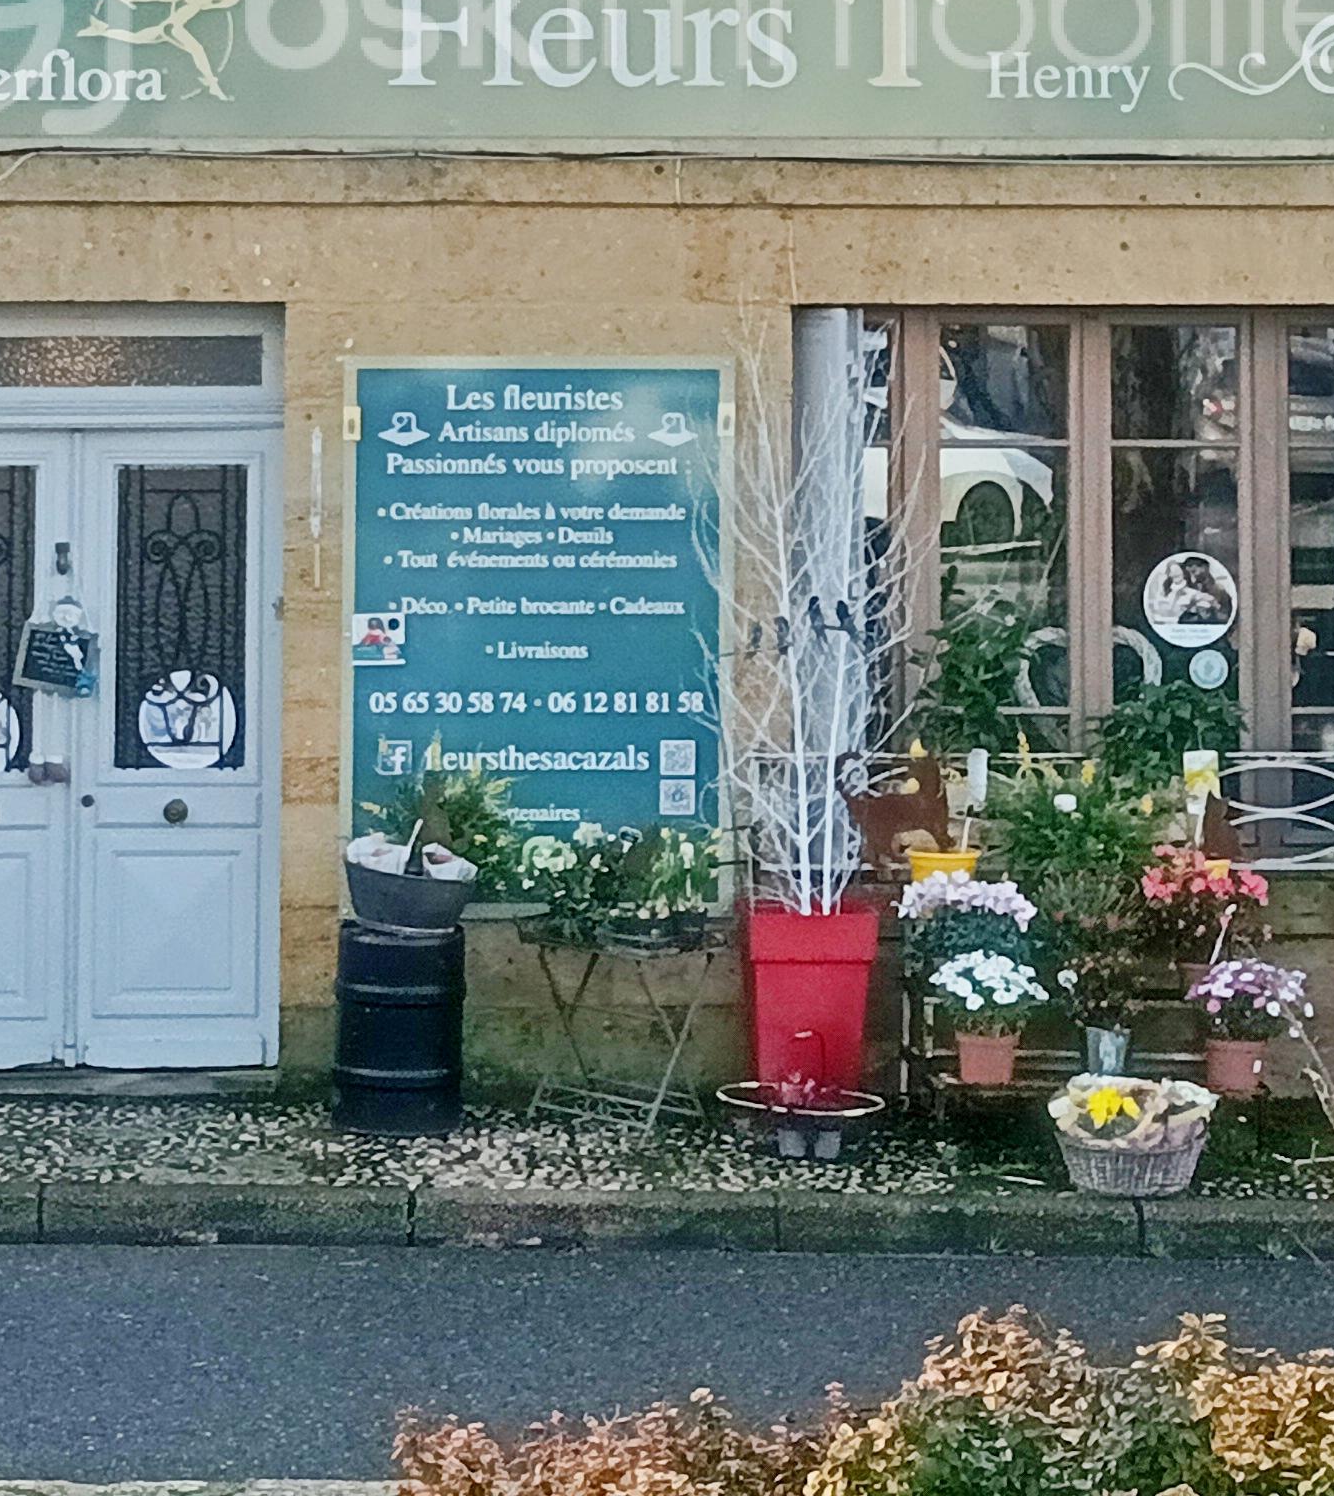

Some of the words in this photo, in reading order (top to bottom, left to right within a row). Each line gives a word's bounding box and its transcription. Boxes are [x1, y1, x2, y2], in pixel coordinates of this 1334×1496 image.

[986, 51, 1151, 112] Henry
[446, 383, 496, 411] Les
[503, 384, 624, 411] fleuristes
[437, 420, 530, 443] Artisans
[534, 421, 636, 447] diplomés
[386, 453, 507, 475] Passionnés
[512, 458, 565, 475] vous
[389, 502, 473, 521] Créations
[477, 502, 542, 521] florales
[559, 505, 605, 521] votre
[607, 502, 687, 521] demande
[462, 526, 543, 549] Mariages
[557, 526, 614, 545] Deuils
[398, 549, 438, 569] Tout
[446, 550, 550, 569] événements
[553, 554, 576, 569] ou
[579, 550, 678, 569] cérémonies
[399, 596, 448, 616] Déco
[466, 596, 517, 615] Petite
[520, 596, 596, 615] brocante
[609, 596, 686, 615] Cadeaux
[497, 640, 589, 659] Livraisons
[368, 691, 398, 714] 05
[402, 691, 430, 714] 65
[434, 691, 463, 714] 30
[466, 691, 495, 714] 58
[499, 691, 528, 713] 74
[547, 691, 577, 713] 06
[583, 691, 609, 713] 12
[613, 691, 638, 714] 81
[645, 691, 670, 714] 81
[677, 690, 705, 714] 58
